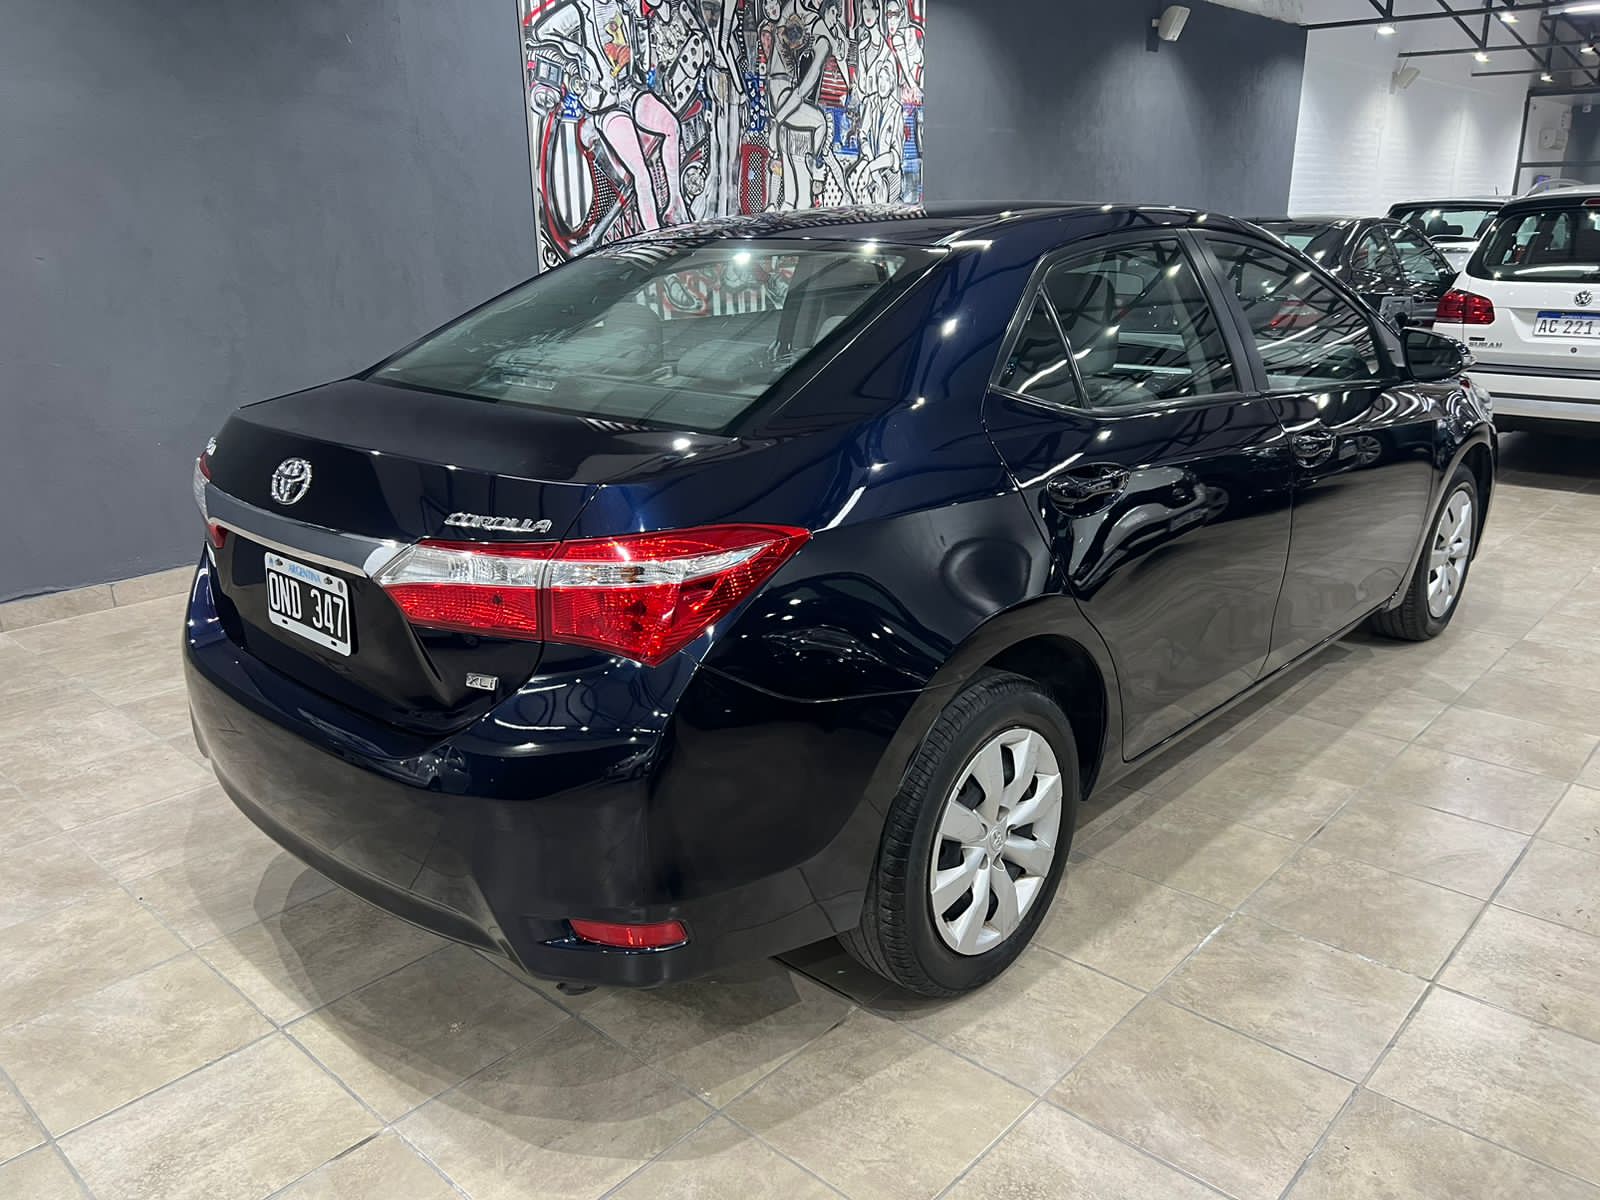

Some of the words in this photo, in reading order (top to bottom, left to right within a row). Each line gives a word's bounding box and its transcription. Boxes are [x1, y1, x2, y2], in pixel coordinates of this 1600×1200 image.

[1538, 319, 1559, 333] AC
[1562, 320, 1593, 335] 221
[444, 511, 552, 534] COROLLA
[268, 571, 302, 620] OND
[310, 588, 344, 638] 347
